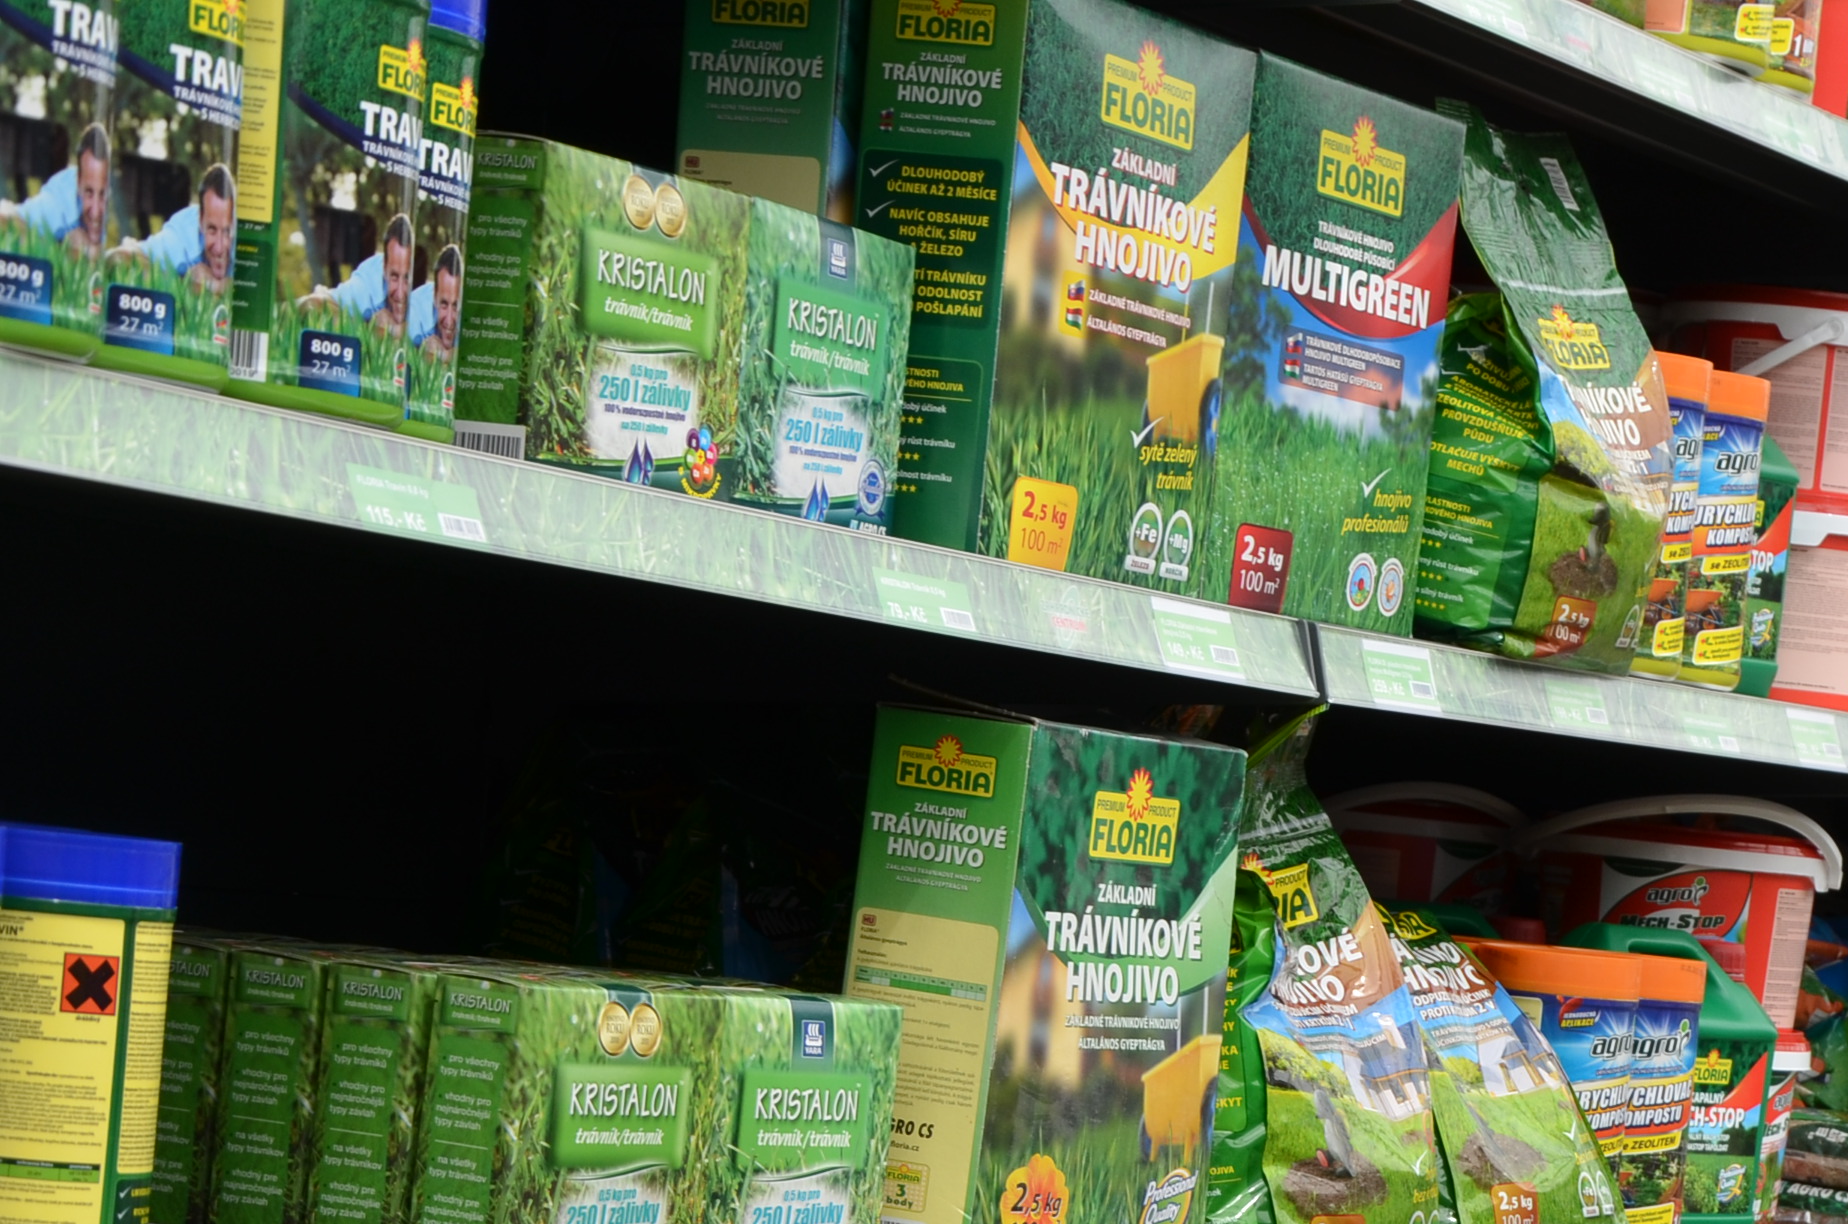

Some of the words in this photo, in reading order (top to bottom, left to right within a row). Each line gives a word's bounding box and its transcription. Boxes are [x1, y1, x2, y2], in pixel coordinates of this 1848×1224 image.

[900, 15, 991, 42] FLORIA
[920, 52, 966, 63] ZÁKLADNÍ
[882, 62, 1002, 89] TRÁVNÍKOVÉ
[898, 84, 982, 108] HNOJIVO
[1103, 83, 1193, 146] FLORIA
[1112, 147, 1176, 186] ZÁKLADNÍ
[1051, 162, 1216, 254] TRÁVNÍKOVÉ
[1075, 220, 1192, 293] HNOJIVO
[598, 248, 706, 305] KRISTALON
[1262, 245, 1430, 331] MULTIGREEN
[120, 293, 153, 312] 800
[156, 296, 166, 318] g
[120, 315, 143, 333] 27
[788, 297, 877, 351] KRISTALON
[1140, 445, 1163, 465] sytě
[1165, 441, 1197, 467] zelený
[1156, 470, 1194, 491] trávník
[1023, 491, 1047, 523] 2,5
[1050, 504, 1068, 530] kg
[1374, 490, 1411, 509] hnojivo
[1342, 512, 1409, 535] profesionálů
[1021, 527, 1044, 551] 100
[1241, 535, 1265, 565] 2,5
[1268, 547, 1284, 570] kg
[900, 765, 990, 793] FLORIA
[914, 802, 967, 819] ZÁKLADNÍ
[1098, 798, 1125, 813] PREMIUM
[1148, 806, 1176, 819] PRODUCT
[871, 811, 1007, 849] TRÁVNÍKOVÉ
[1093, 819, 1172, 859] FLORIA
[887, 836, 984, 868] HNOJIVO
[1098, 883, 1156, 907] ZÁKLADNÍ
[1045, 907, 1202, 959] TRÁVNÍKOVÉ
[244, 968, 305, 989] KRISTALON
[1066, 962, 1179, 1004] HNOJIVO
[451, 992, 511, 1014] KRISTALON
[1066, 1015, 1101, 1029] ZÁKLADNÉ
[1150, 1018, 1179, 1030] HNOJIVO
[1120, 1037, 1165, 1051] GYEPTRÁGYA
[440, 1067, 460, 1080] typy
[463, 1054, 499, 1071] všechny
[569, 1083, 678, 1118] KRISTALON
[755, 1087, 858, 1122] KRISTALON
[918, 1123, 934, 1139] CS
[896, 1184, 905, 1196] 3
[1011, 1183, 1039, 1214] 2,5
[1043, 1193, 1061, 1215] kg
[1146, 1171, 1196, 1203] Professional
[886, 1198, 913, 1208] body
